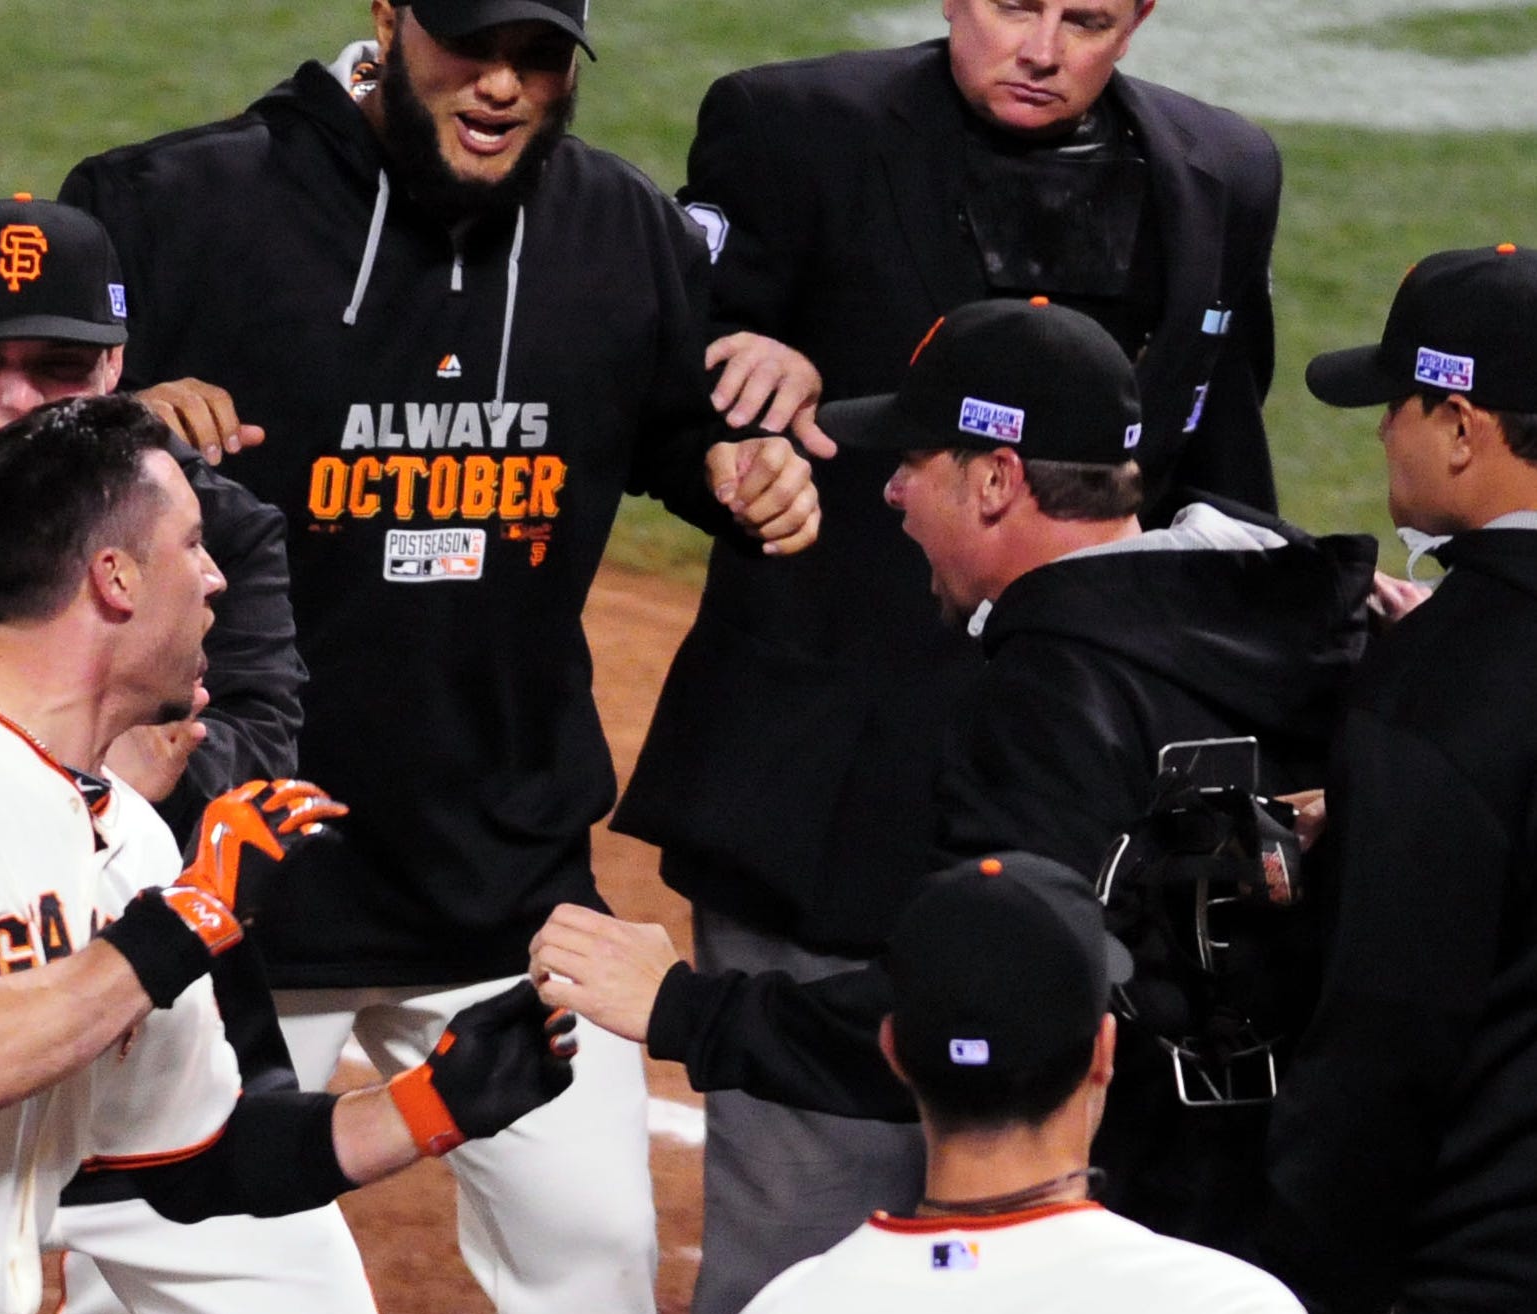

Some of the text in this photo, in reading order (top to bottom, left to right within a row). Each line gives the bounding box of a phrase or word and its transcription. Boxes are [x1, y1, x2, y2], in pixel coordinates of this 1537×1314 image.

[341, 402, 549, 449] ALWAYS
[308, 455, 568, 520] OCTOBER
[388, 533, 471, 555] POSTSEASON
